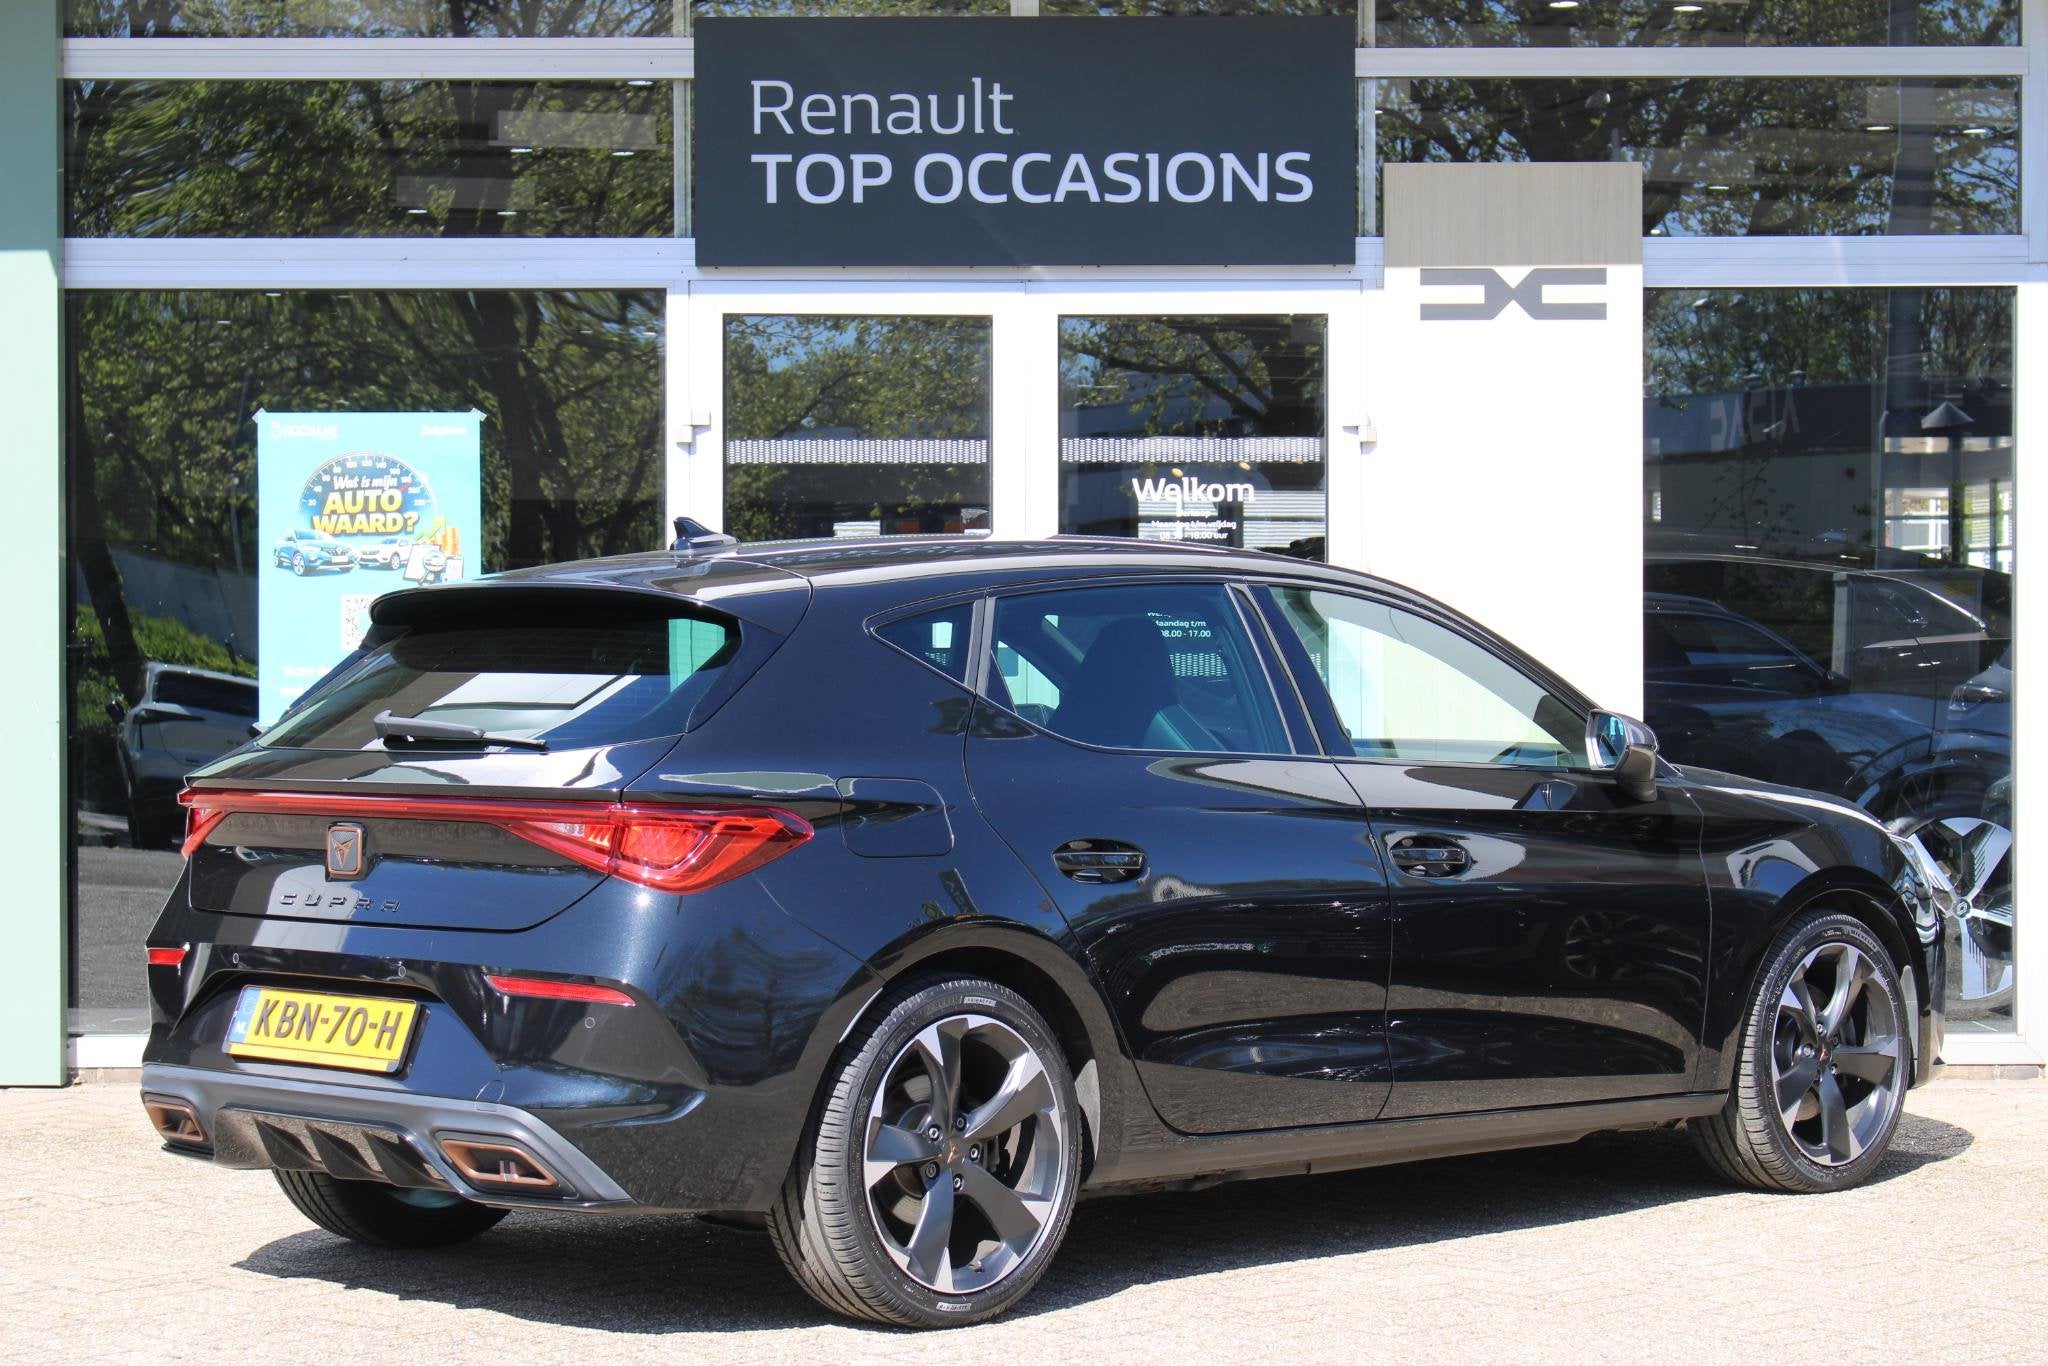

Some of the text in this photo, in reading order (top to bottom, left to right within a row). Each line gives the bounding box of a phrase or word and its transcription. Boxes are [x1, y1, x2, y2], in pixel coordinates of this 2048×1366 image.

[751, 78, 1014, 135] Renault
[751, 152, 1314, 204] TOP OCCASIONS
[334, 474, 398, 491] Wat is mijn
[1131, 476, 1256, 503] Welkom
[308, 498, 317, 507] 20
[322, 489, 402, 515] AUTO
[312, 511, 421, 535] WAARD?
[1191, 531, 1212, 540] 18.00
[1214, 531, 1229, 539] uur
[1189, 629, 1211, 638] 17.00
[1190, 620, 1207, 628] t/m
[280, 893, 400, 912] CUPRA
[254, 998, 403, 1050] KBN-70-H
